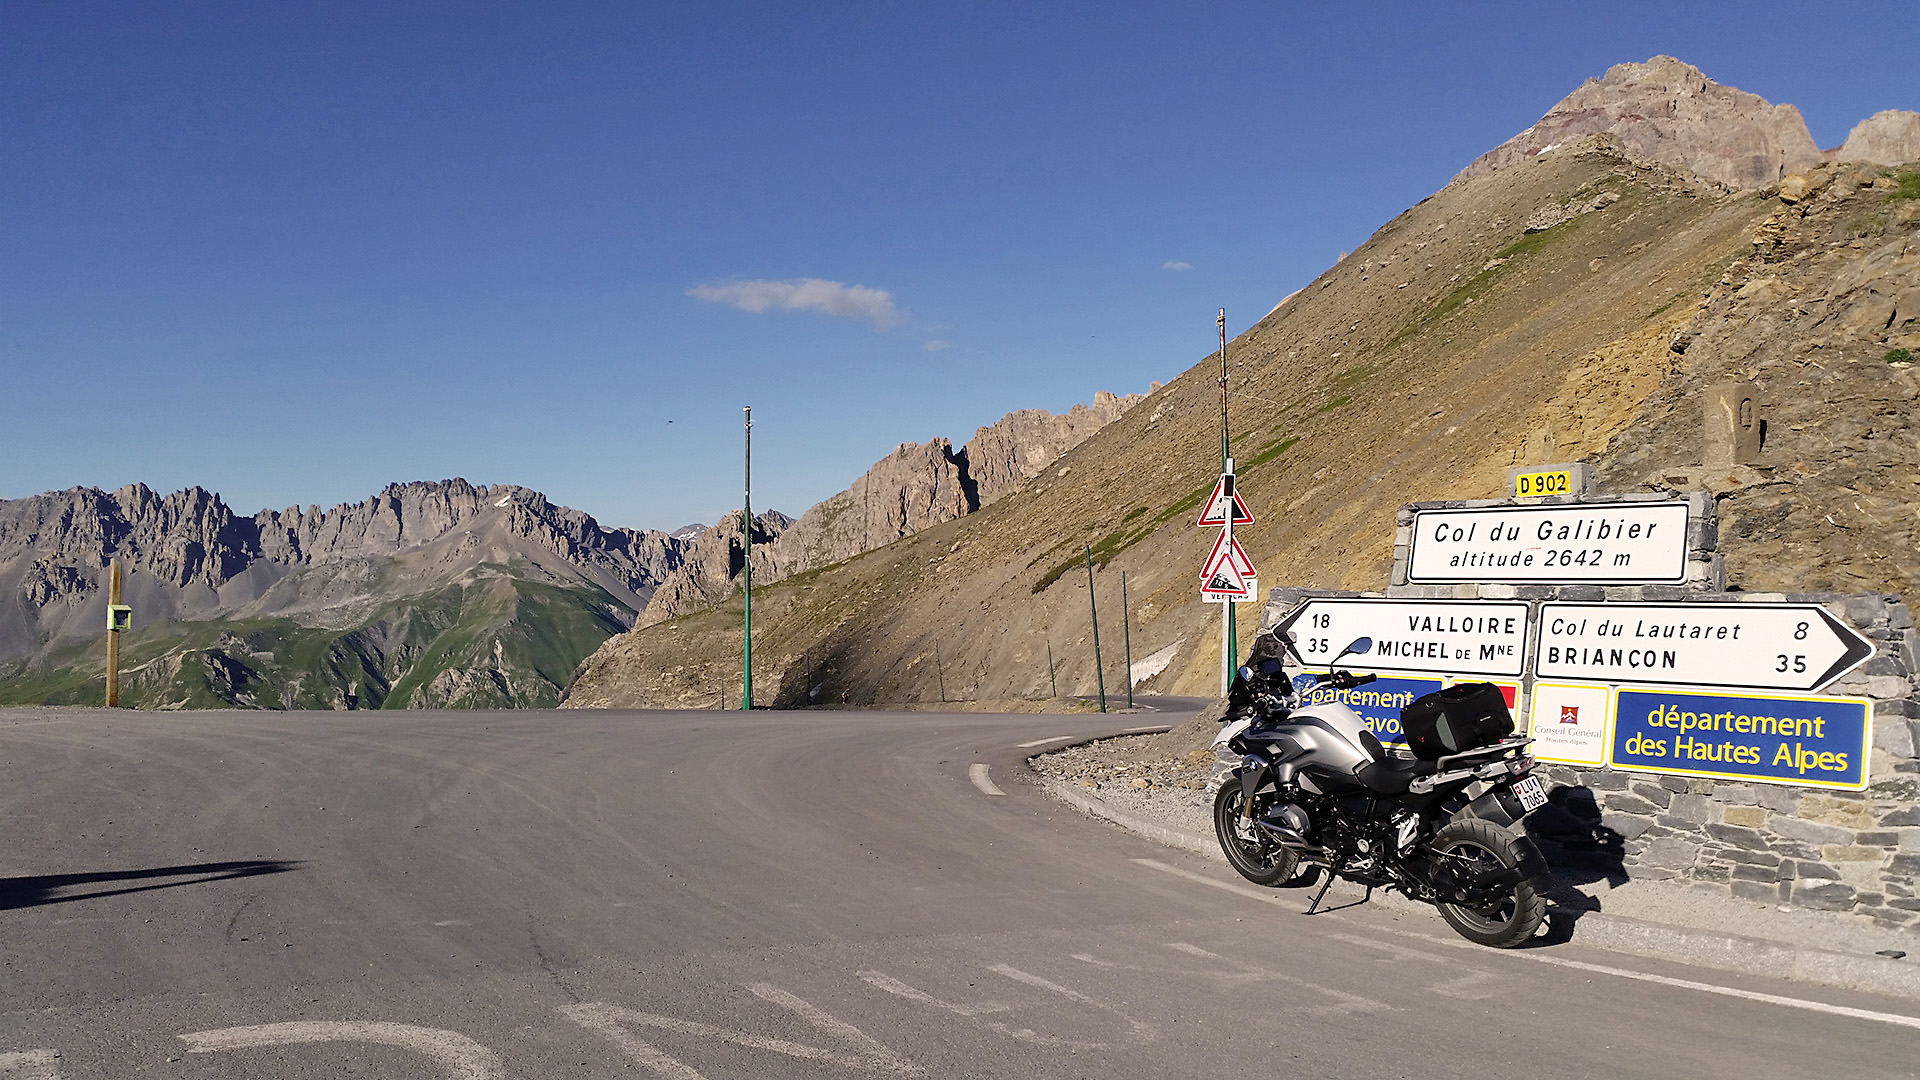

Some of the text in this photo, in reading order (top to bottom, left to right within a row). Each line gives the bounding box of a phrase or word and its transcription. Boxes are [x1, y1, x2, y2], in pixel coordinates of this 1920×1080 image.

[1520, 475, 1566, 494] D 902
[1434, 518, 1657, 542] Col du Galibier
[1450, 549, 1631, 567] altitude 2642 m
[1312, 613, 1330, 629] 18
[1409, 615, 1516, 634] VALLOIRE
[1551, 618, 1741, 641] Col du Lautaret
[1794, 622, 1809, 640] 8
[1308, 638, 1329, 653] 35
[1378, 641, 1449, 659] MICHEL
[1455, 649, 1471, 660] DE
[1548, 646, 1677, 669] BRIANÇON
[1775, 655, 1807, 673] 35
[1647, 704, 1826, 738] département
[1534, 725, 1602, 738] Conseil Général
[1569, 738, 1588, 746] Alpes
[1624, 732, 1849, 774] des Hautes Alpes
[1520, 780, 1533, 793] LU
[1523, 791, 1545, 808] 7065
